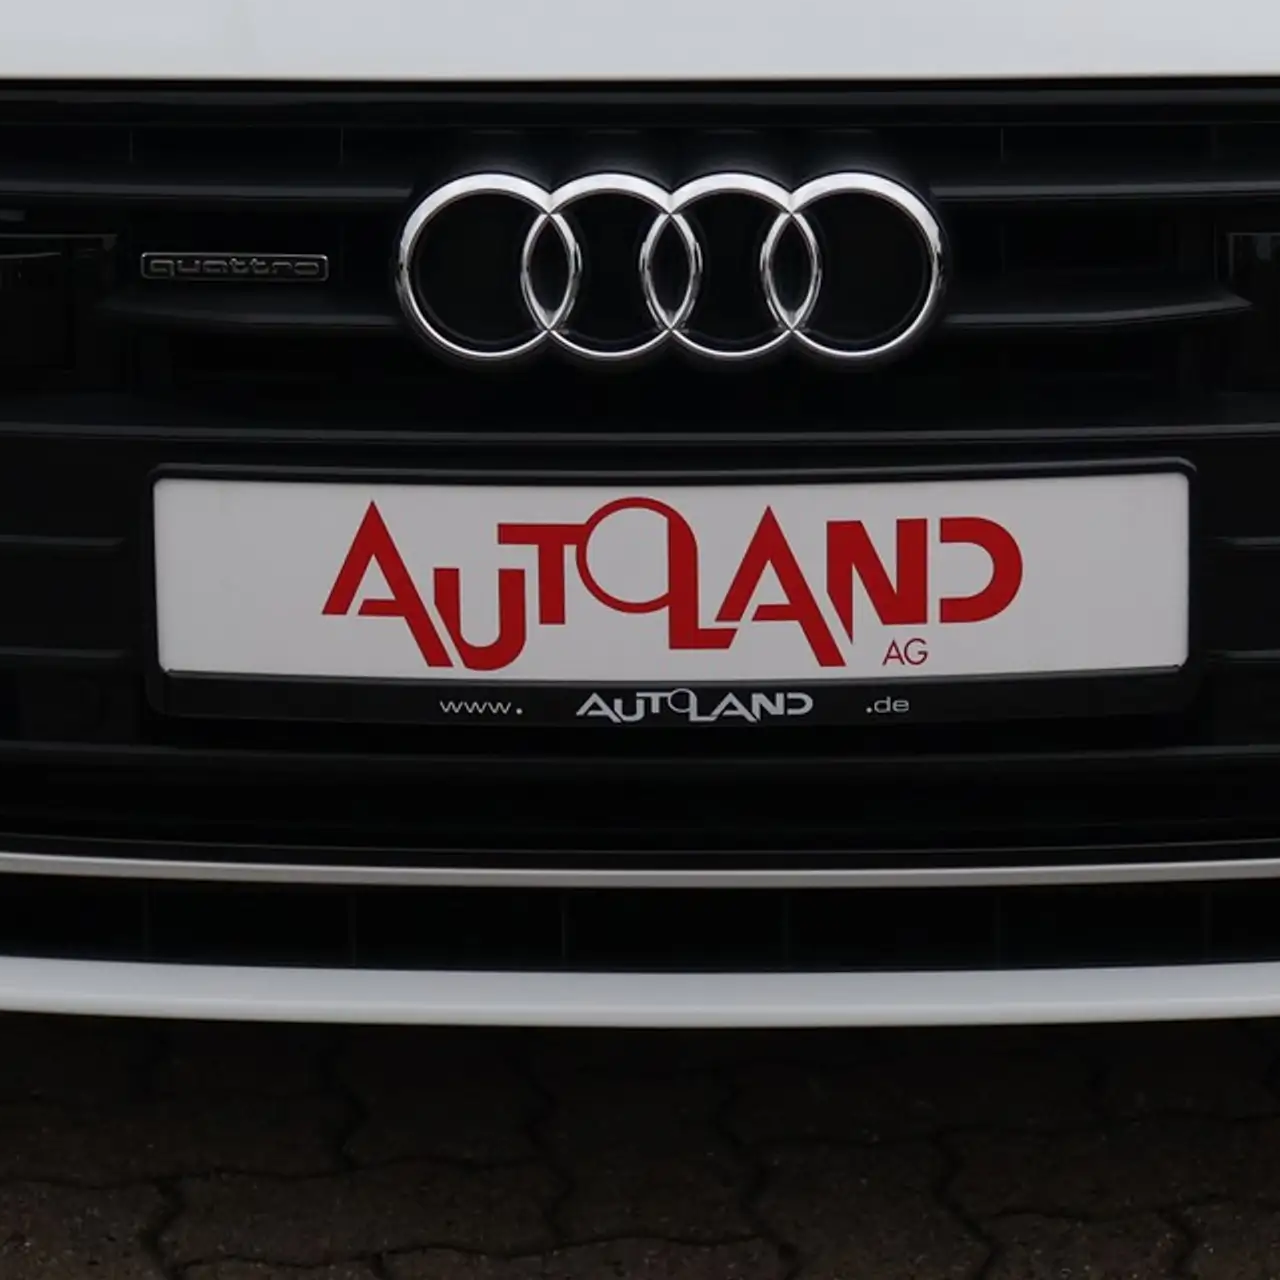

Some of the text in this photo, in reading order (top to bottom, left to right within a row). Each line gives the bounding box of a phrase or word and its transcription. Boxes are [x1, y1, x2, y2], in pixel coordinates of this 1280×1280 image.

[149, 256, 320, 278] quattro
[322, 496, 1024, 671] AUTOLAND
[882, 637, 928, 666] AG
[439, 687, 910, 723] www. AUTOLAND .de
